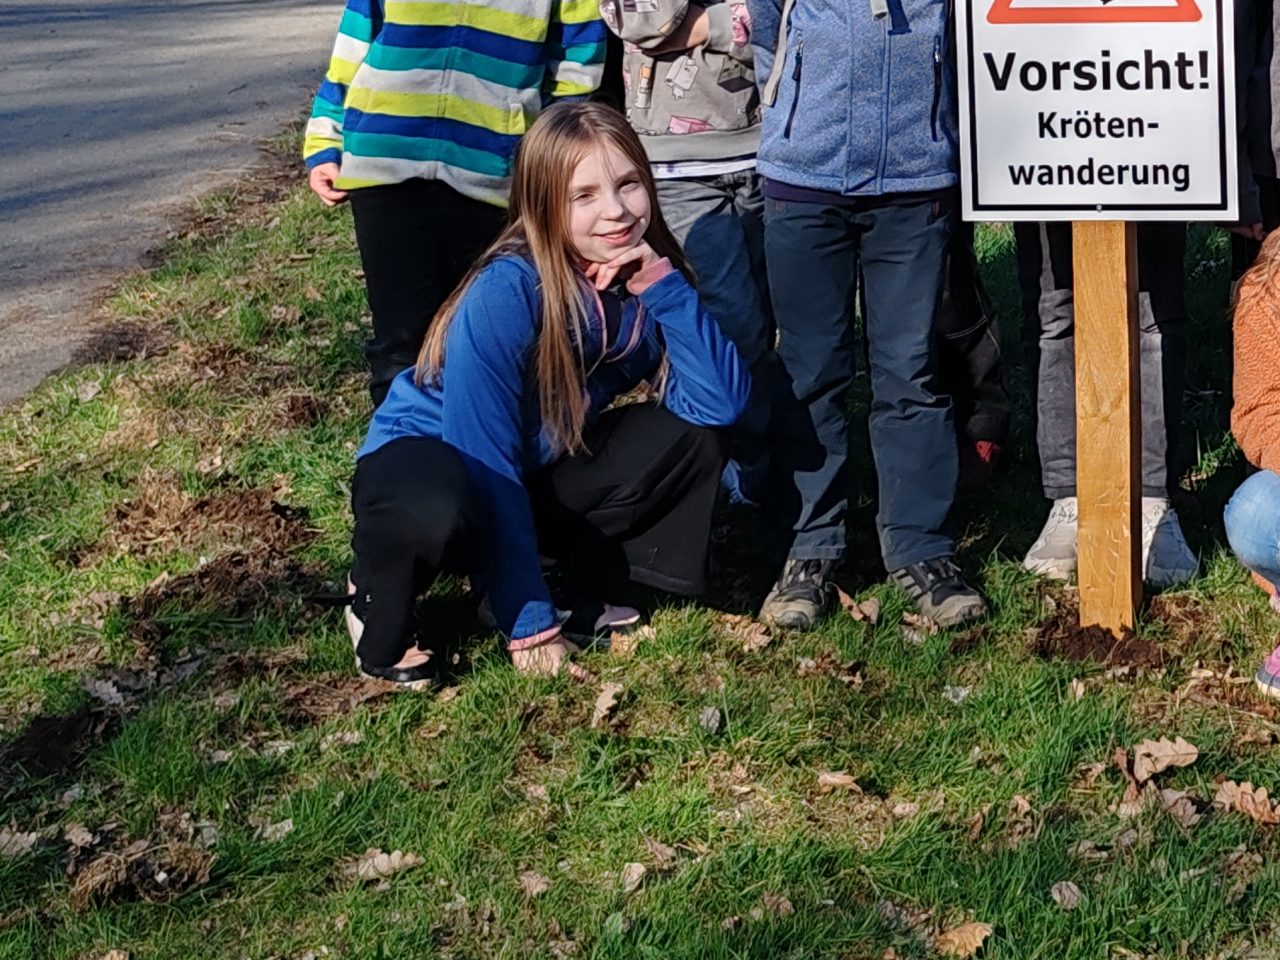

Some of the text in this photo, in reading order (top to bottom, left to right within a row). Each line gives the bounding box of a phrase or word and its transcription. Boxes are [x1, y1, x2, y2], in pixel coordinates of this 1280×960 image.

[983, 50, 1210, 91] Vorsicht!
[1038, 111, 1159, 139] Kröten-
[1009, 157, 1190, 191] wanderung
